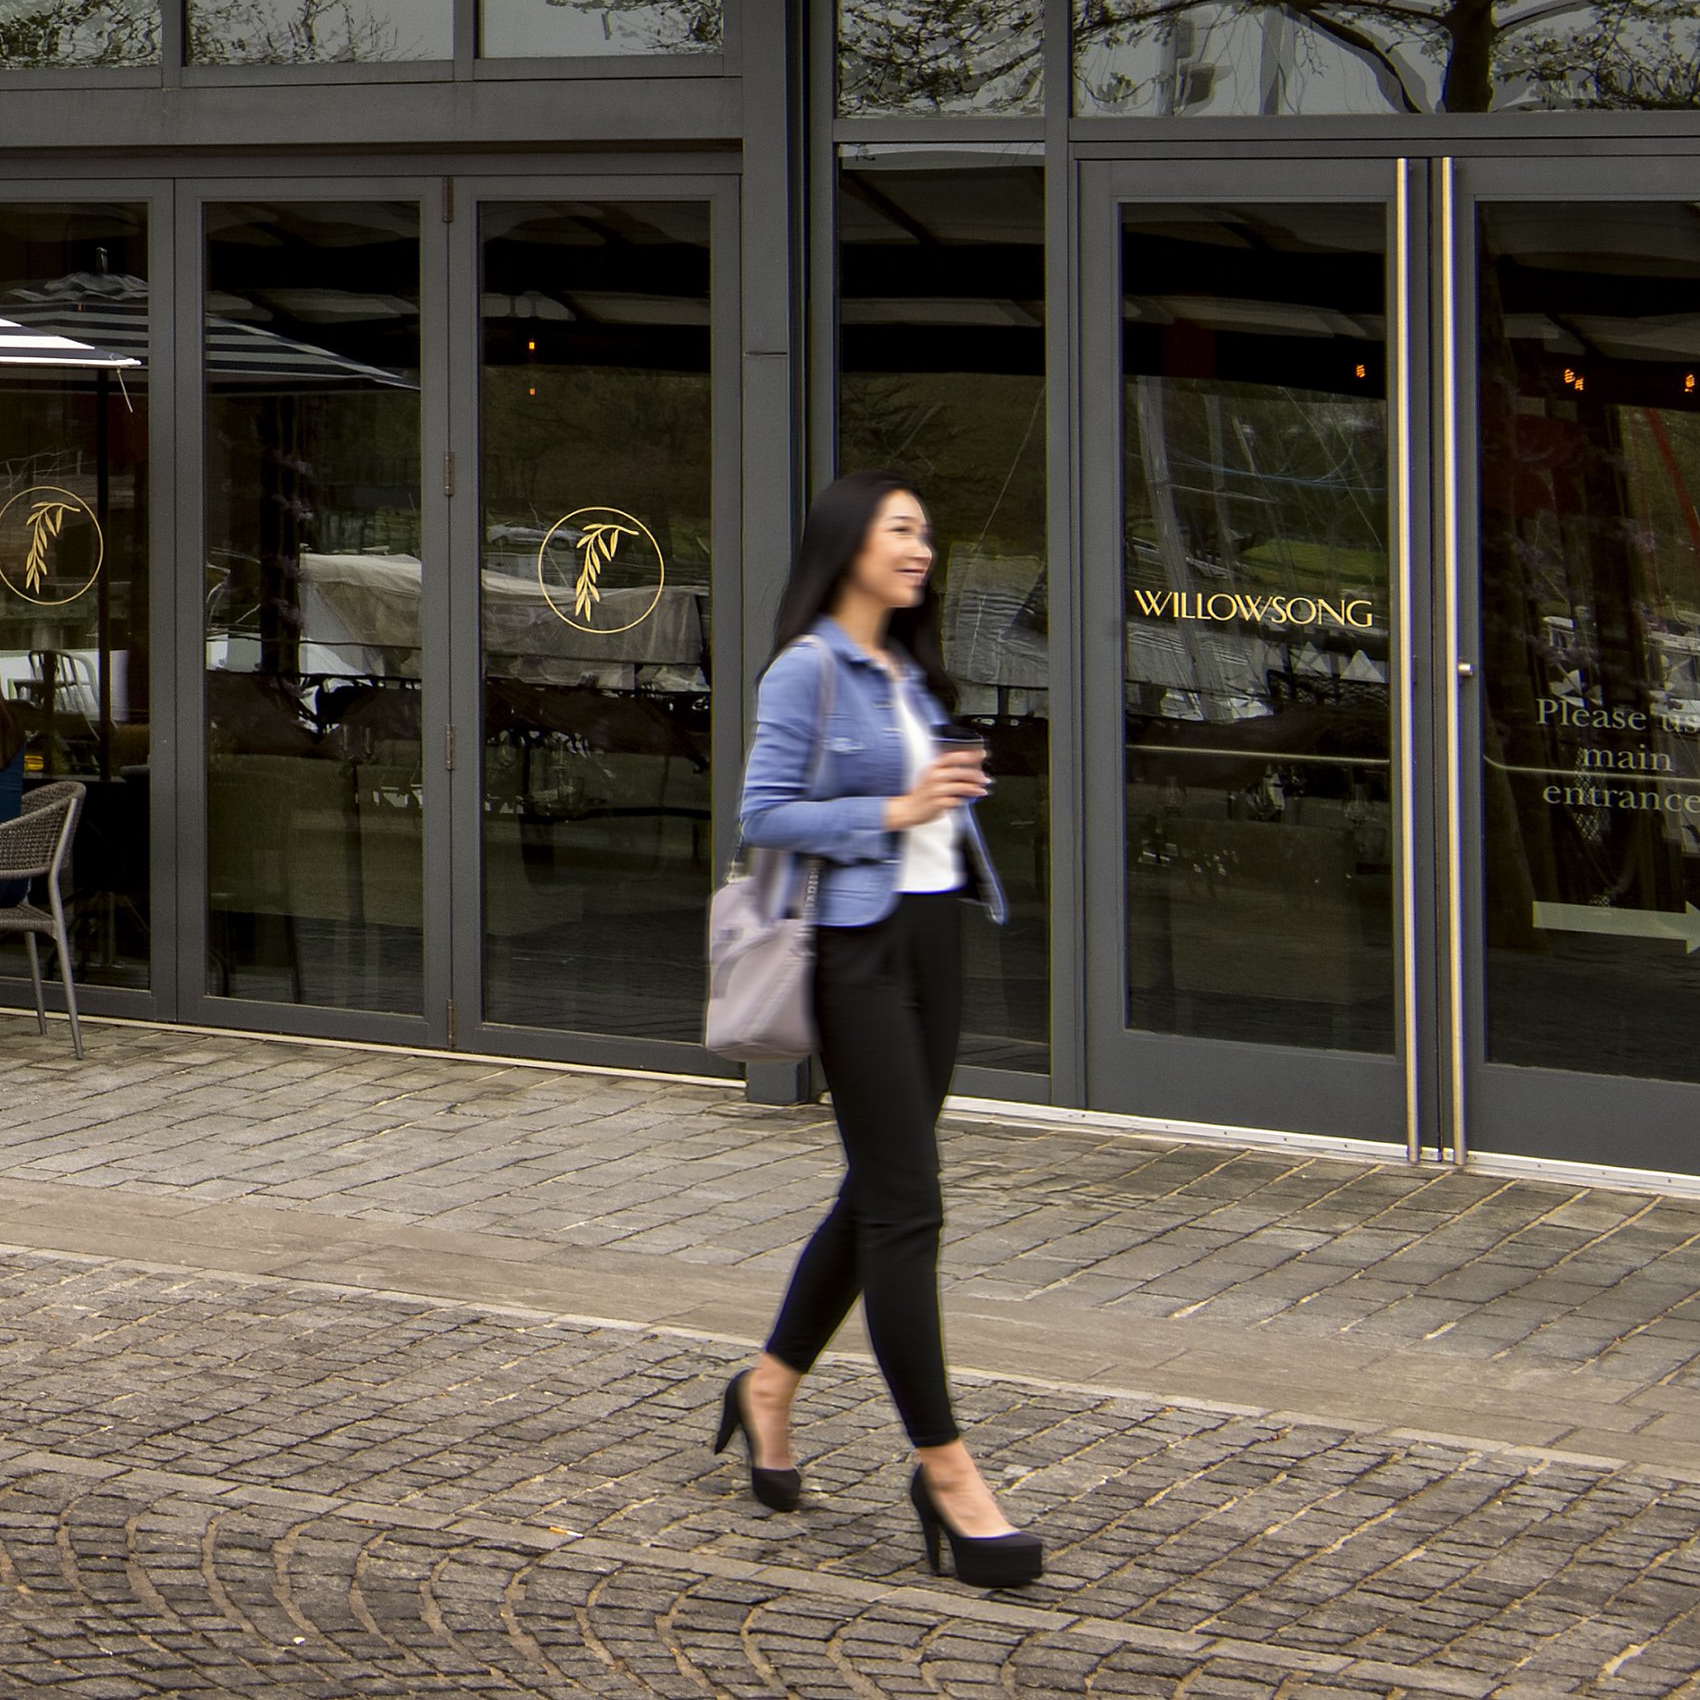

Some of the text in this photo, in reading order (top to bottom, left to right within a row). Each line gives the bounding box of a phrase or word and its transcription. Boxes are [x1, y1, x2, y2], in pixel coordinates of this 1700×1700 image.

[1134, 589, 1373, 628] WILLOWSONG
[1536, 698, 1647, 731] Please
[1582, 743, 1675, 772] main
[1542, 784, 1700, 814] entrance
